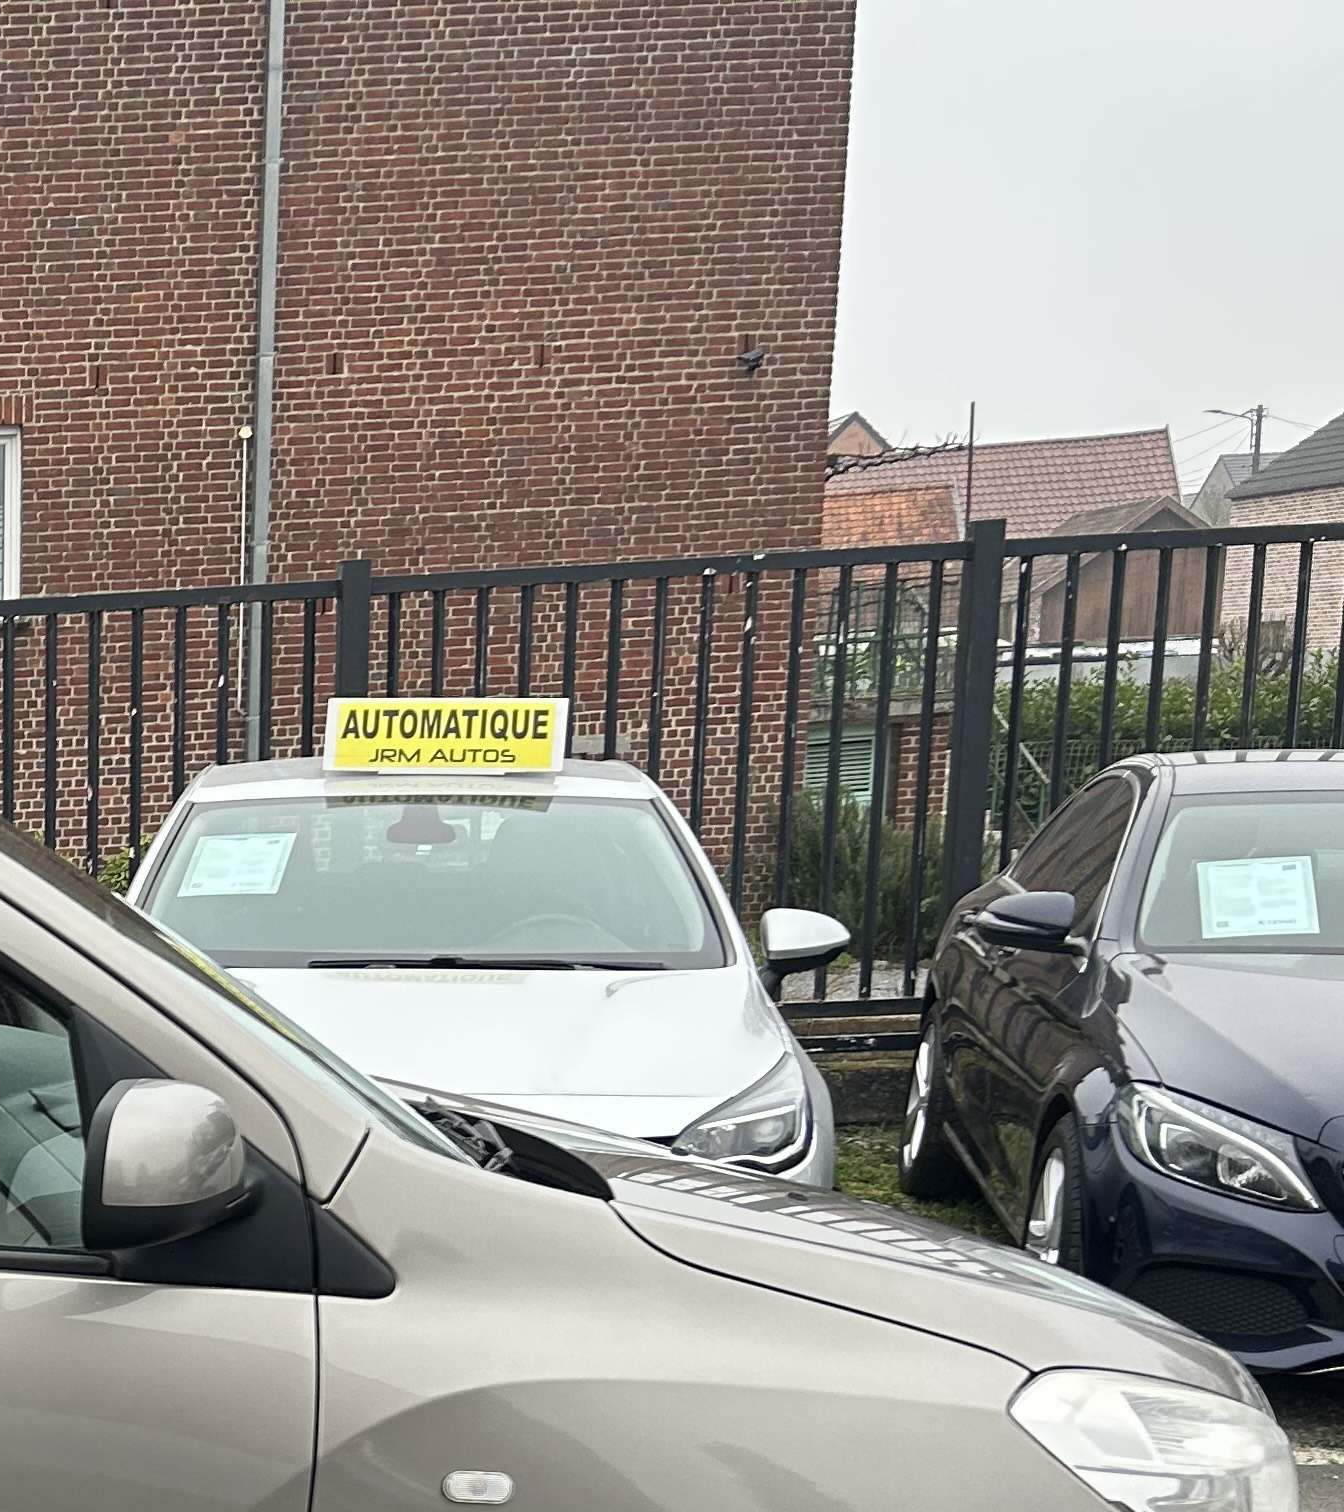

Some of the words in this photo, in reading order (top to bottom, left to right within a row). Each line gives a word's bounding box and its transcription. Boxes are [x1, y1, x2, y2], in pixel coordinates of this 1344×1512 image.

[341, 709, 549, 741] AUTOMATIQUE
[368, 748, 421, 763] JRM
[428, 748, 516, 763] AUTOS
